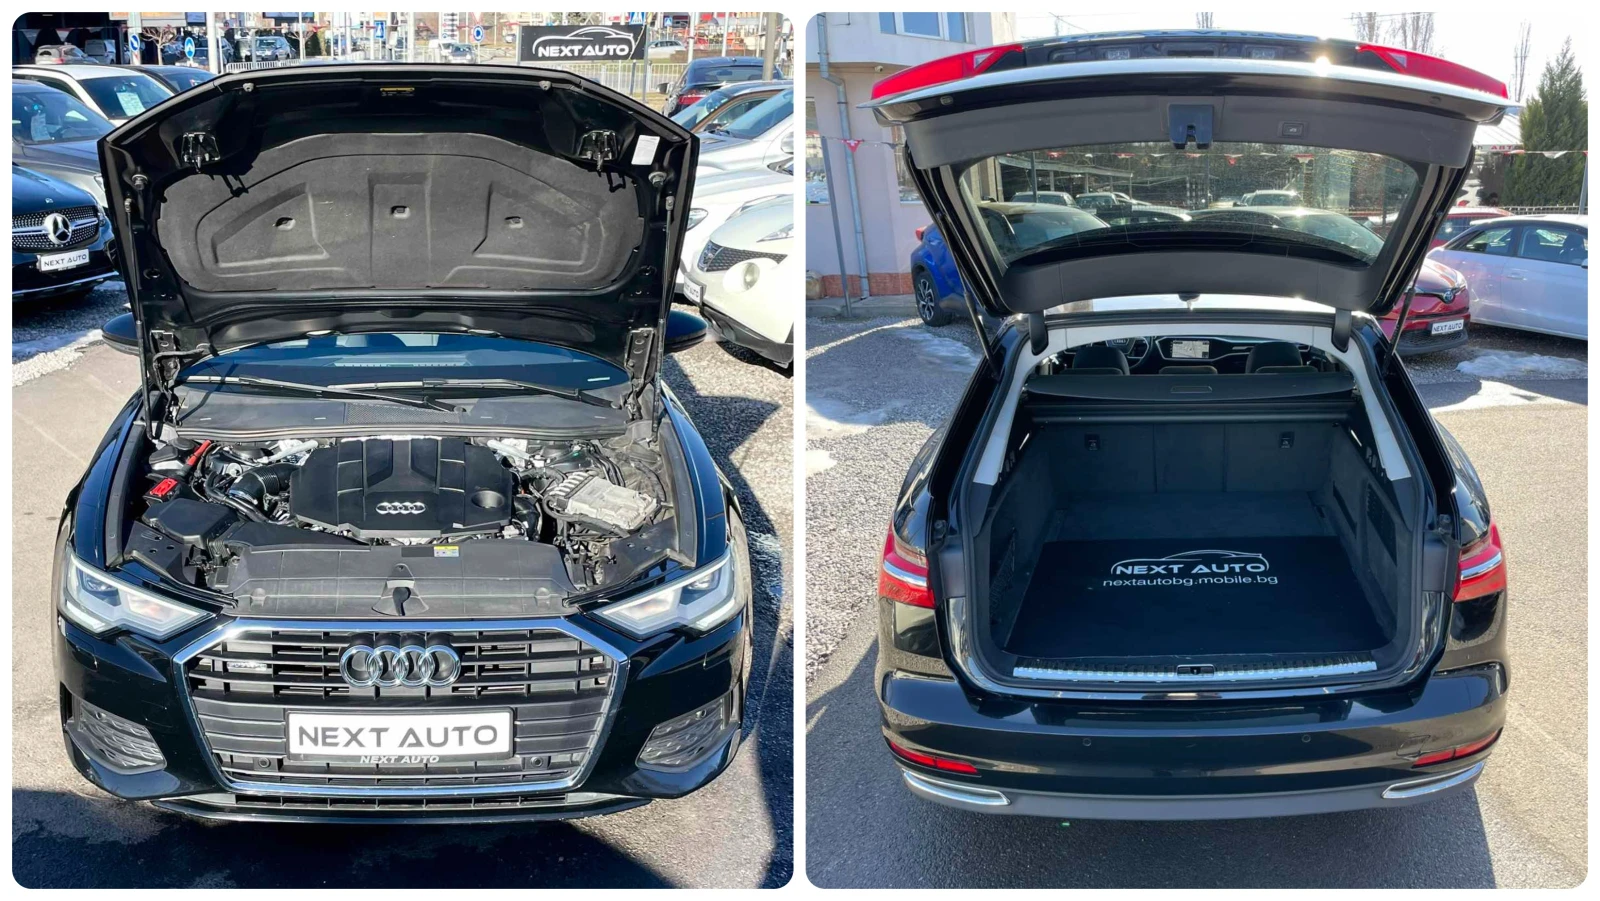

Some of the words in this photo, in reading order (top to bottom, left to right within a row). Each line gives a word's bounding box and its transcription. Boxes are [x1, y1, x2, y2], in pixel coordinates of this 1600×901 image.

[538, 45, 582, 57] NEXT
[582, 44, 629, 56] AUTO
[43, 258, 65, 268] NEXT
[67, 253, 87, 263] AUTO
[1433, 324, 1448, 332] NEXT
[1448, 322, 1462, 330] AUTO
[1116, 564, 1184, 574] NEXT
[1191, 563, 1265, 574] AUTO
[1103, 575, 1278, 587] nextautobg.mobile.bg
[298, 726, 389, 748] NEXT
[398, 725, 498, 748] AUTO
[360, 755, 398, 764] NEXT
[400, 754, 440, 763] AUTO
